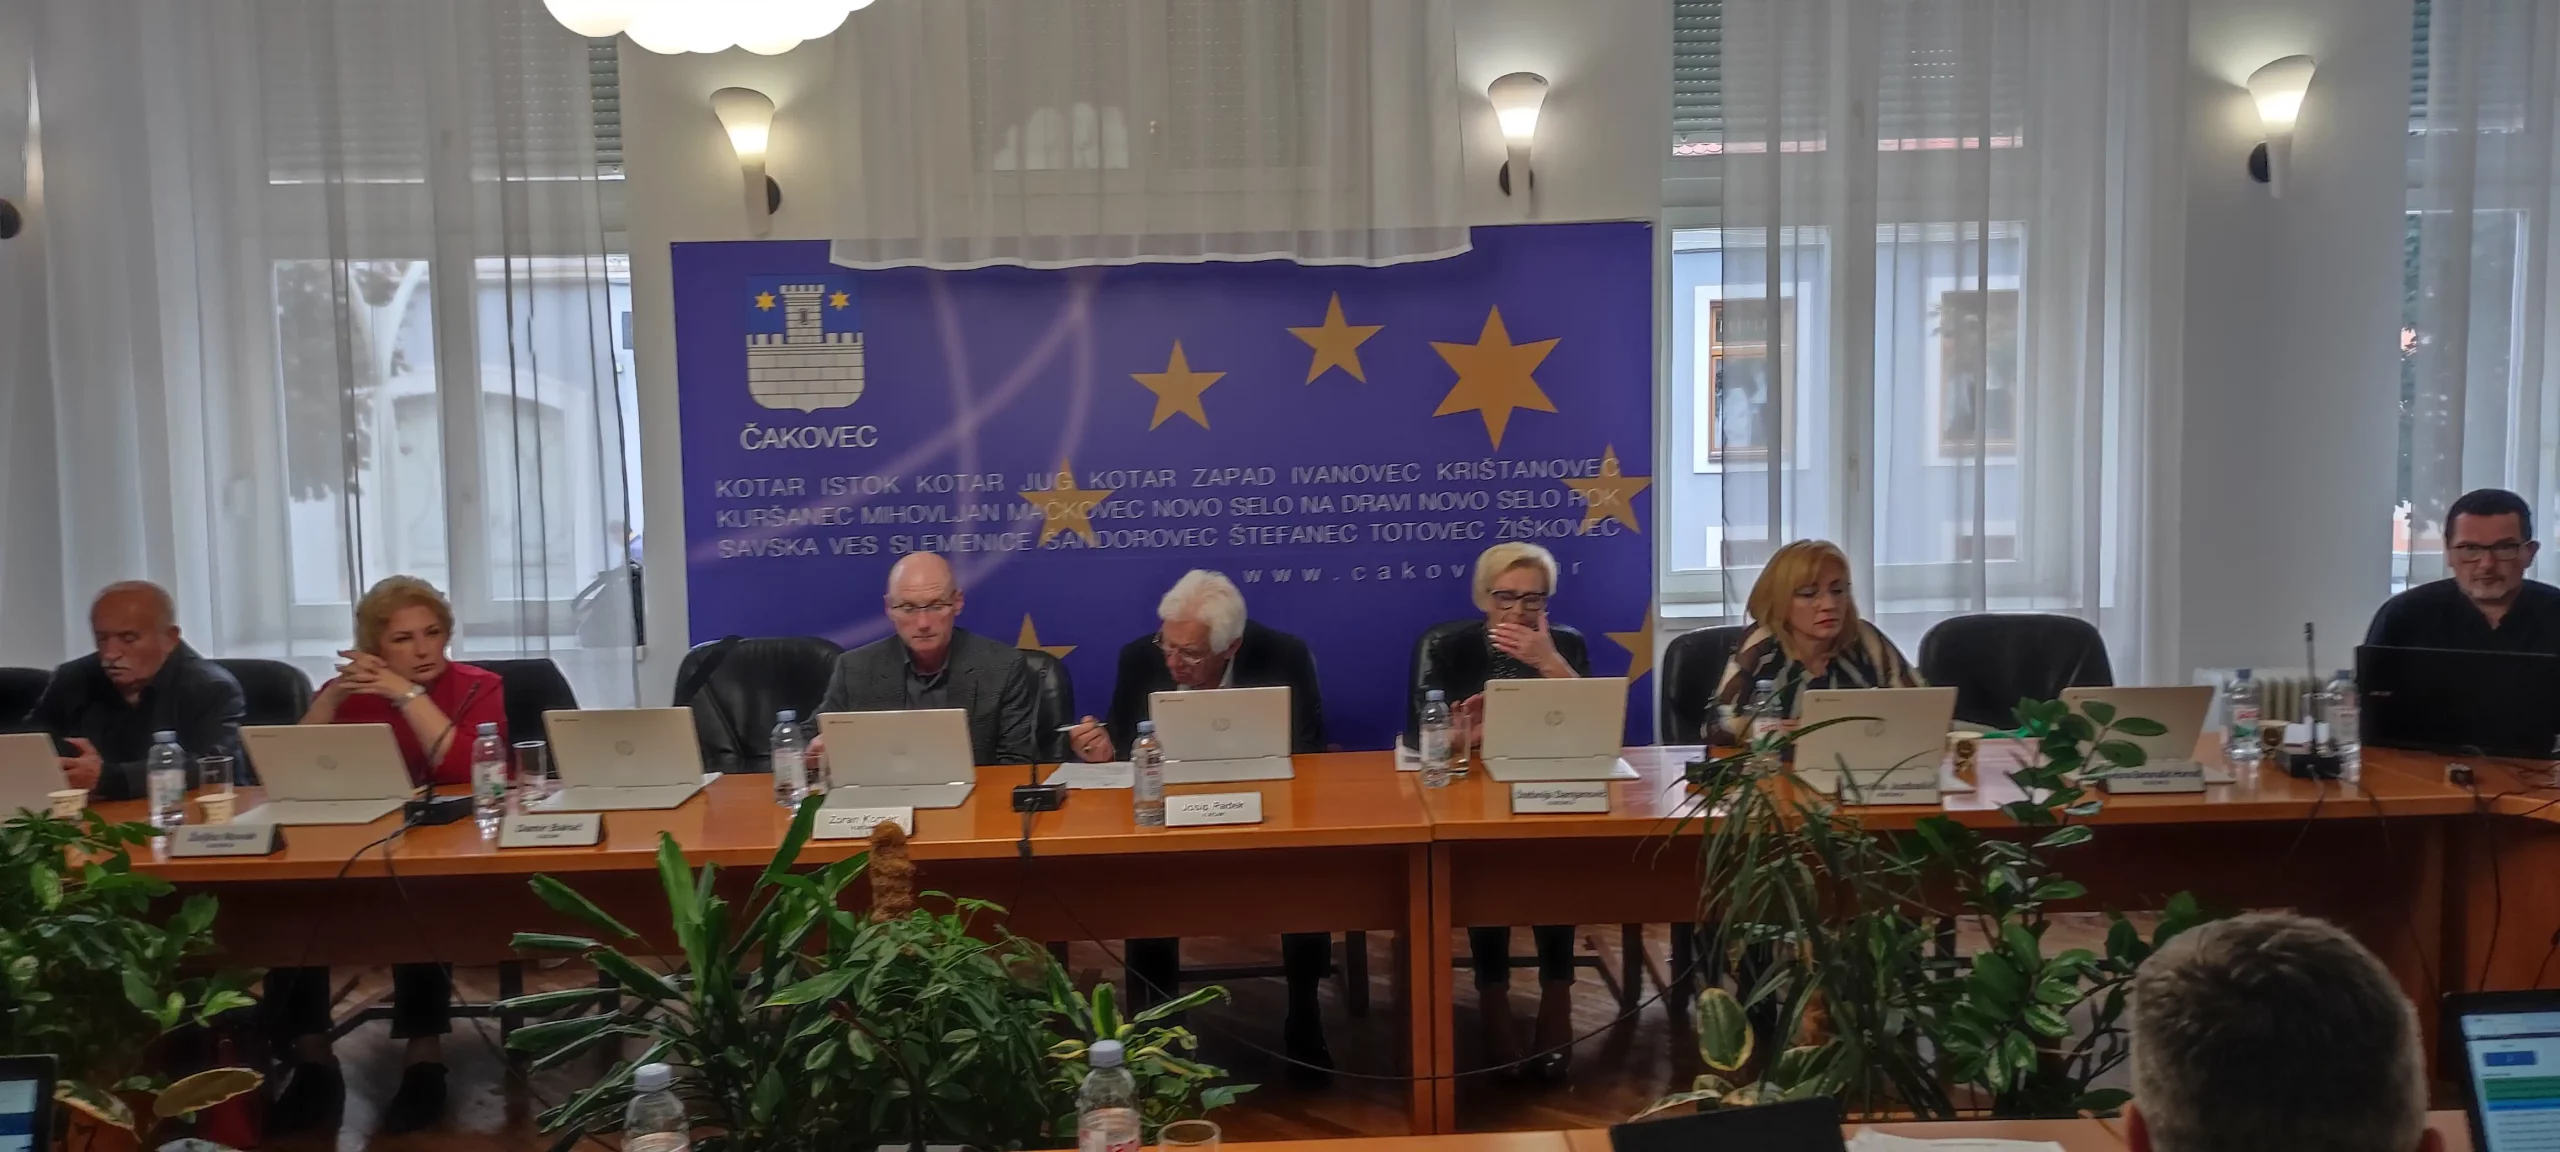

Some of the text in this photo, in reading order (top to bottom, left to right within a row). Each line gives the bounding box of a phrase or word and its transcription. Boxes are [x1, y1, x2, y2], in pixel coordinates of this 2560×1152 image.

[740, 422, 878, 450] ČAKOVEC
[715, 457, 1620, 498] KOTAR ISTOK KOTAR JUG KOTAR ZAPAD IVANOVEC KRIŠTANOVEC
[716, 487, 1622, 528] KURŠANEC MIHOVLJAN MAČKOVEC NOVO SELO NA DRAVI NOVO SELO ROK
[717, 515, 1621, 559] SAVSKA VES SLEMENICE ŠANDOROVEC ŠTEFANEC TOTOVEC ŽIŠKOVEC
